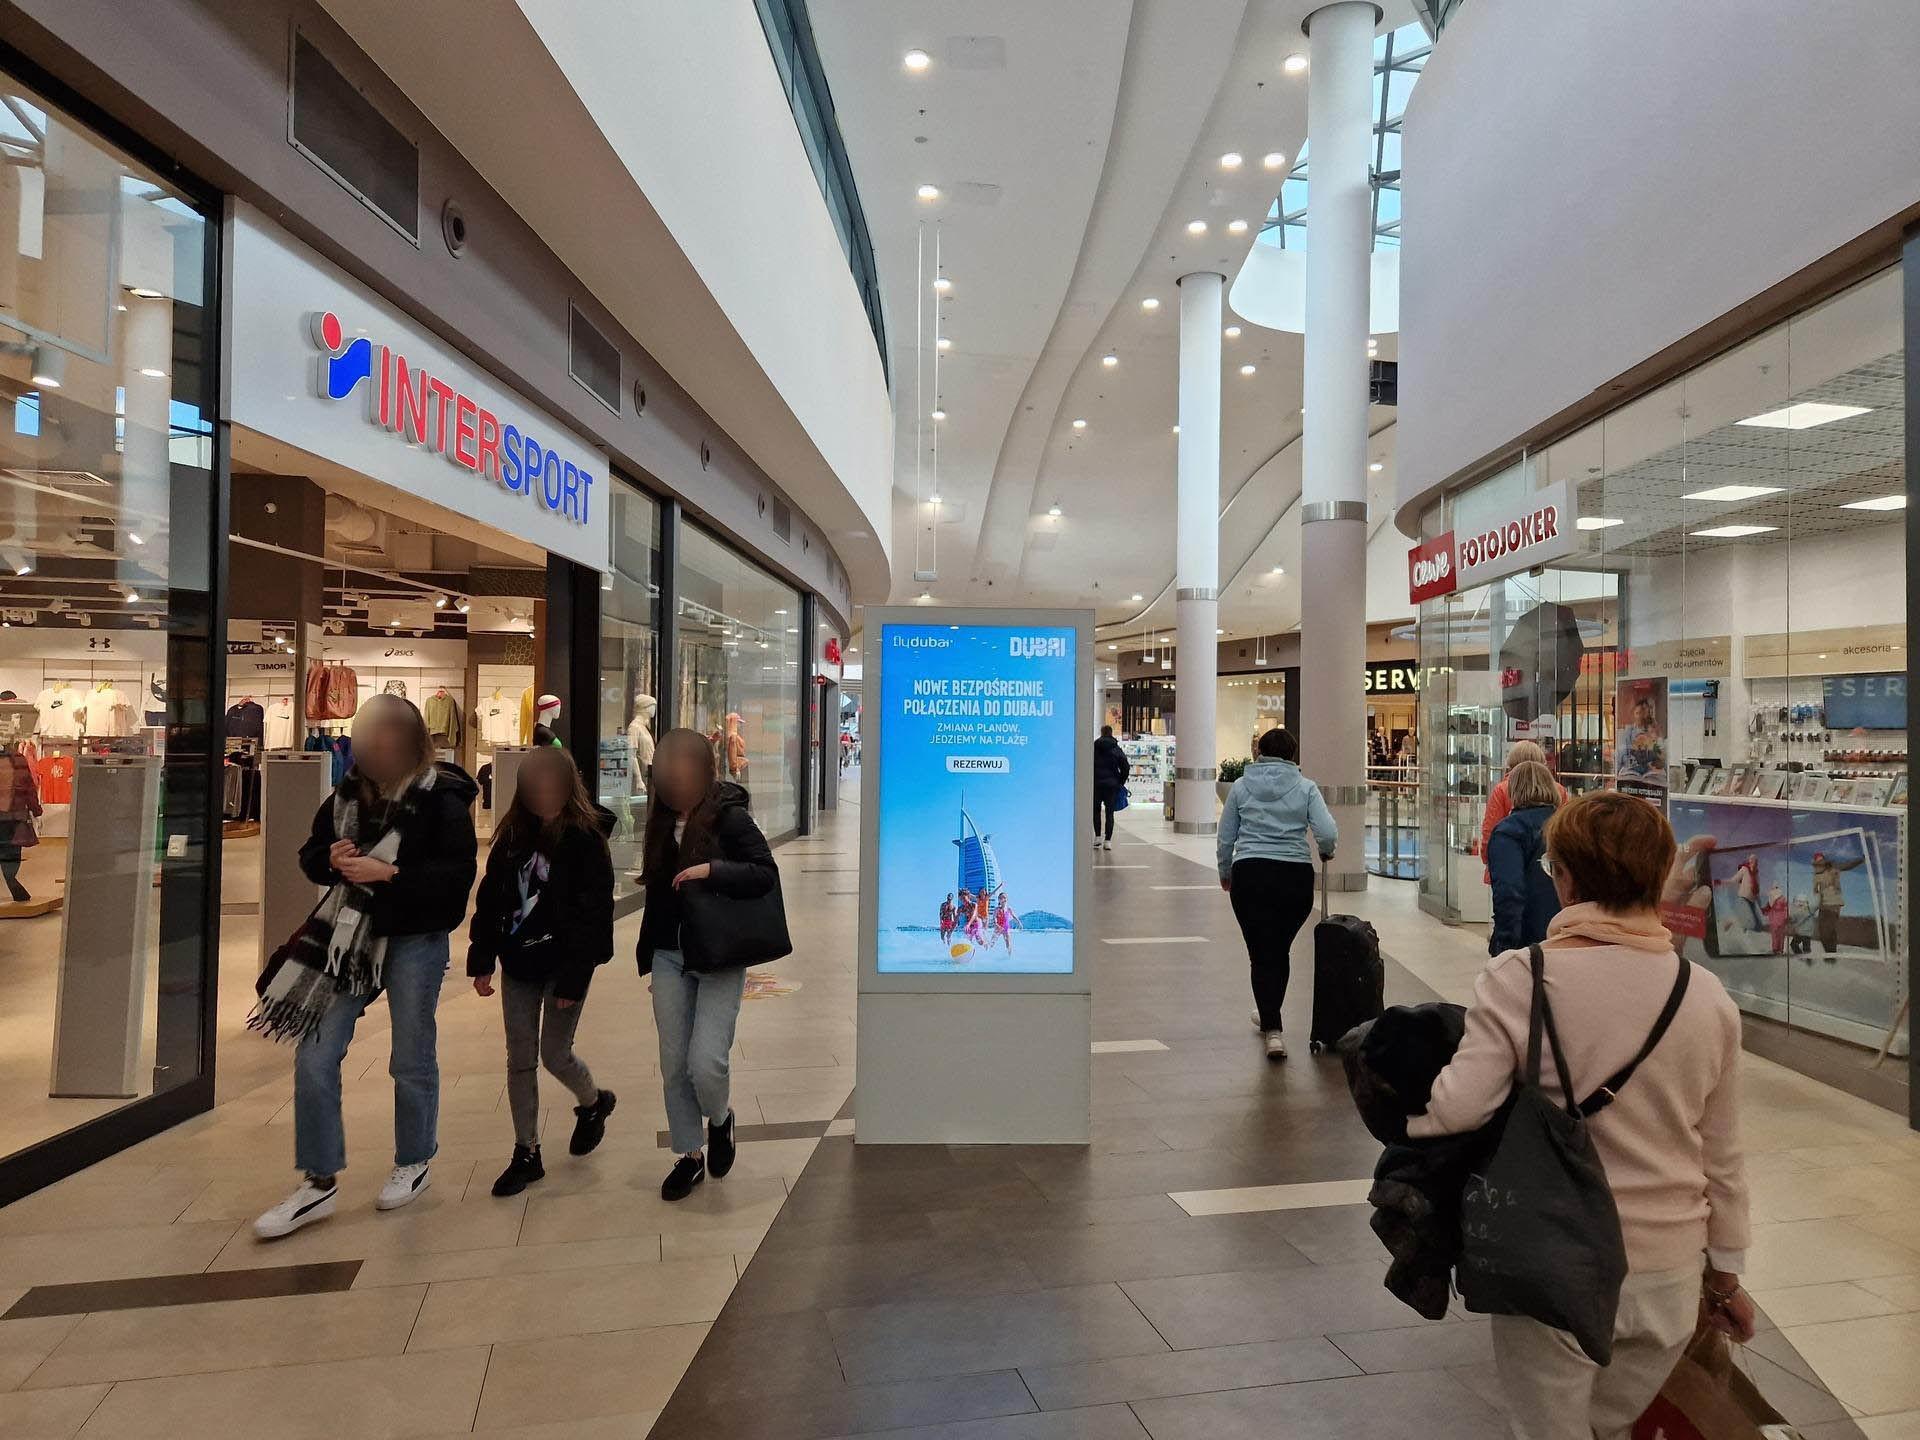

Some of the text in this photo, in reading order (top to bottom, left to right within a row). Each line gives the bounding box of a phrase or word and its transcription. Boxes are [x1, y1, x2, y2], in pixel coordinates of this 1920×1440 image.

[377, 345, 593, 526] INTERSPORT
[1459, 505, 1558, 571] FOTOJOKER
[393, 648, 415, 657] asics
[1010, 636, 1066, 659] DUBAI
[1842, 643, 1892, 656] akcesoria
[914, 678, 1044, 698] NOWE BEZPOŚREDNIE
[903, 699, 1053, 718] POŁĄCZENIA DO DUBAJU
[937, 722, 975, 733] ZMIANA
[930, 734, 1028, 747] JEDZIEMY NA PLAŻĘ!
[953, 760, 1003, 770] REZERWUJ
